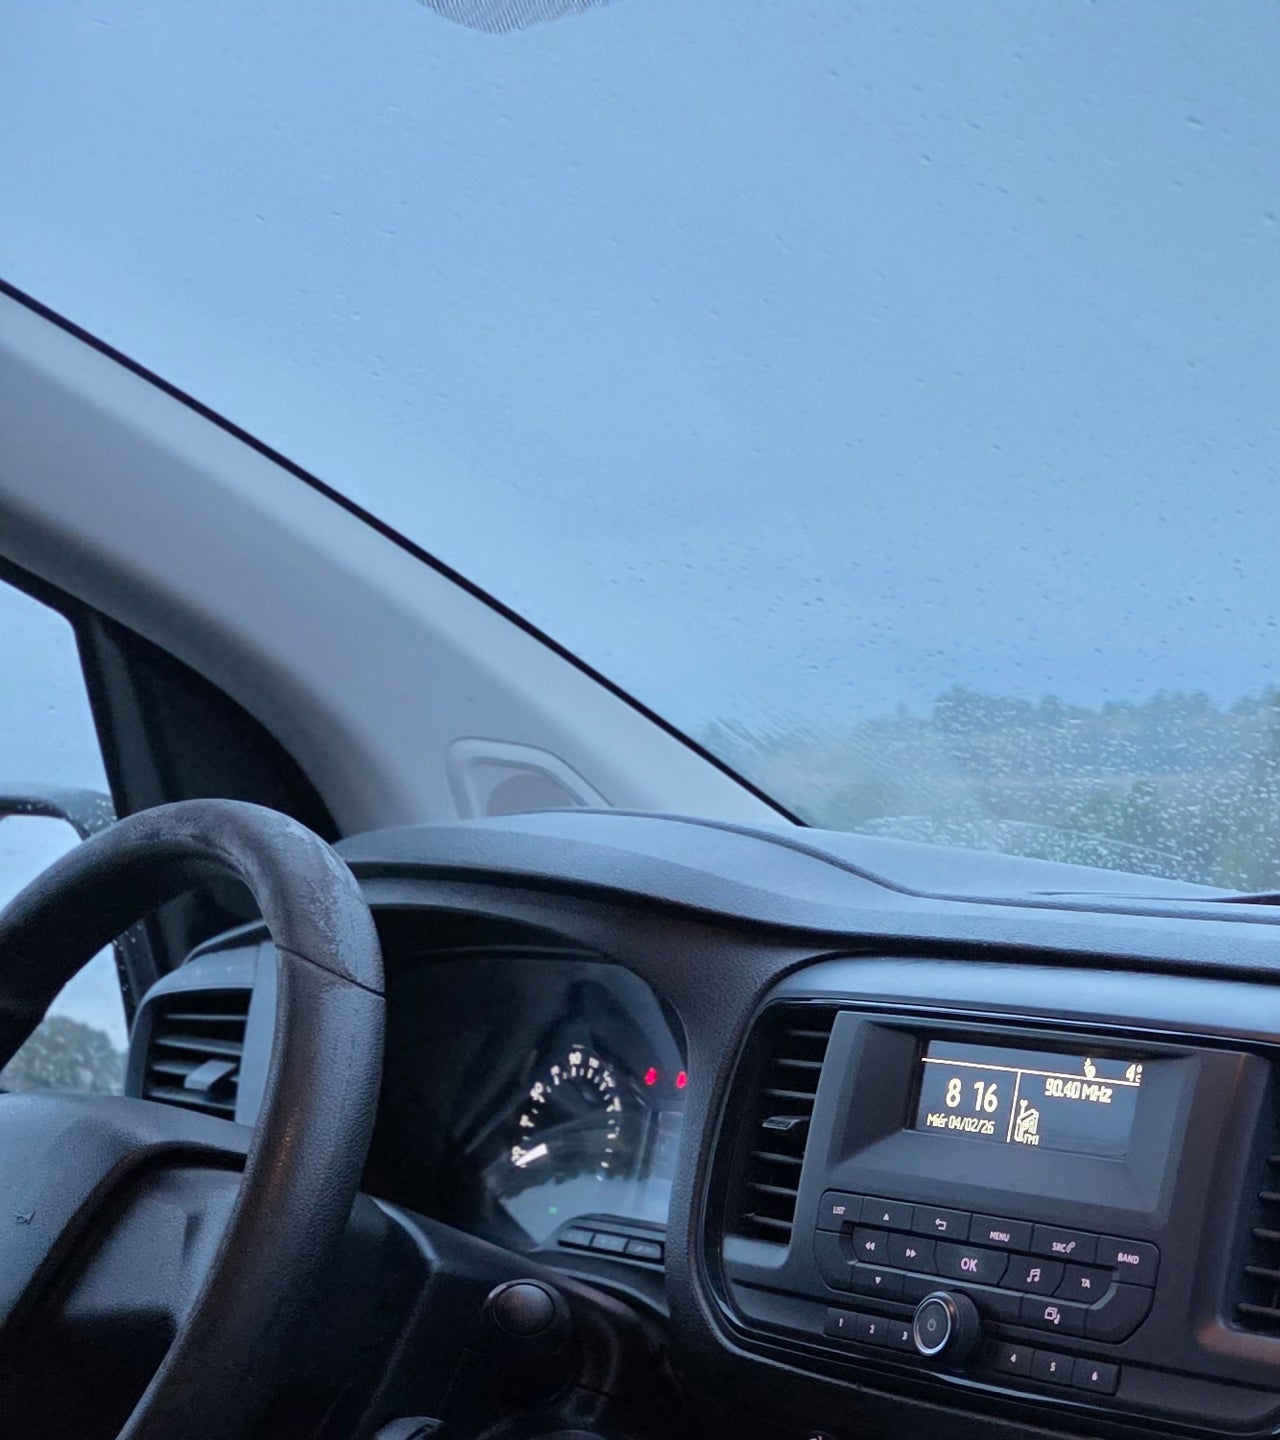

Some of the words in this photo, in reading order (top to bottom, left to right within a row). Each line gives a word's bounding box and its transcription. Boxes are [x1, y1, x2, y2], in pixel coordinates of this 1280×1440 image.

[1045, 1078, 1081, 1099] 90.40
[832, 1206, 846, 1216] LIST
[989, 1230, 1011, 1243] MENU
[1051, 1241, 1067, 1254] SRC
[1117, 1252, 1140, 1265] BAND
[960, 1257, 978, 1273] OK
[1081, 1278, 1091, 1289] TA
[838, 1318, 843, 1328] 1
[869, 1324, 875, 1334] 2
[902, 1330, 908, 1341] 3
[1010, 1353, 1017, 1363] 4
[1050, 1362, 1056, 1372] 5
[1091, 1371, 1098, 1382] 6
